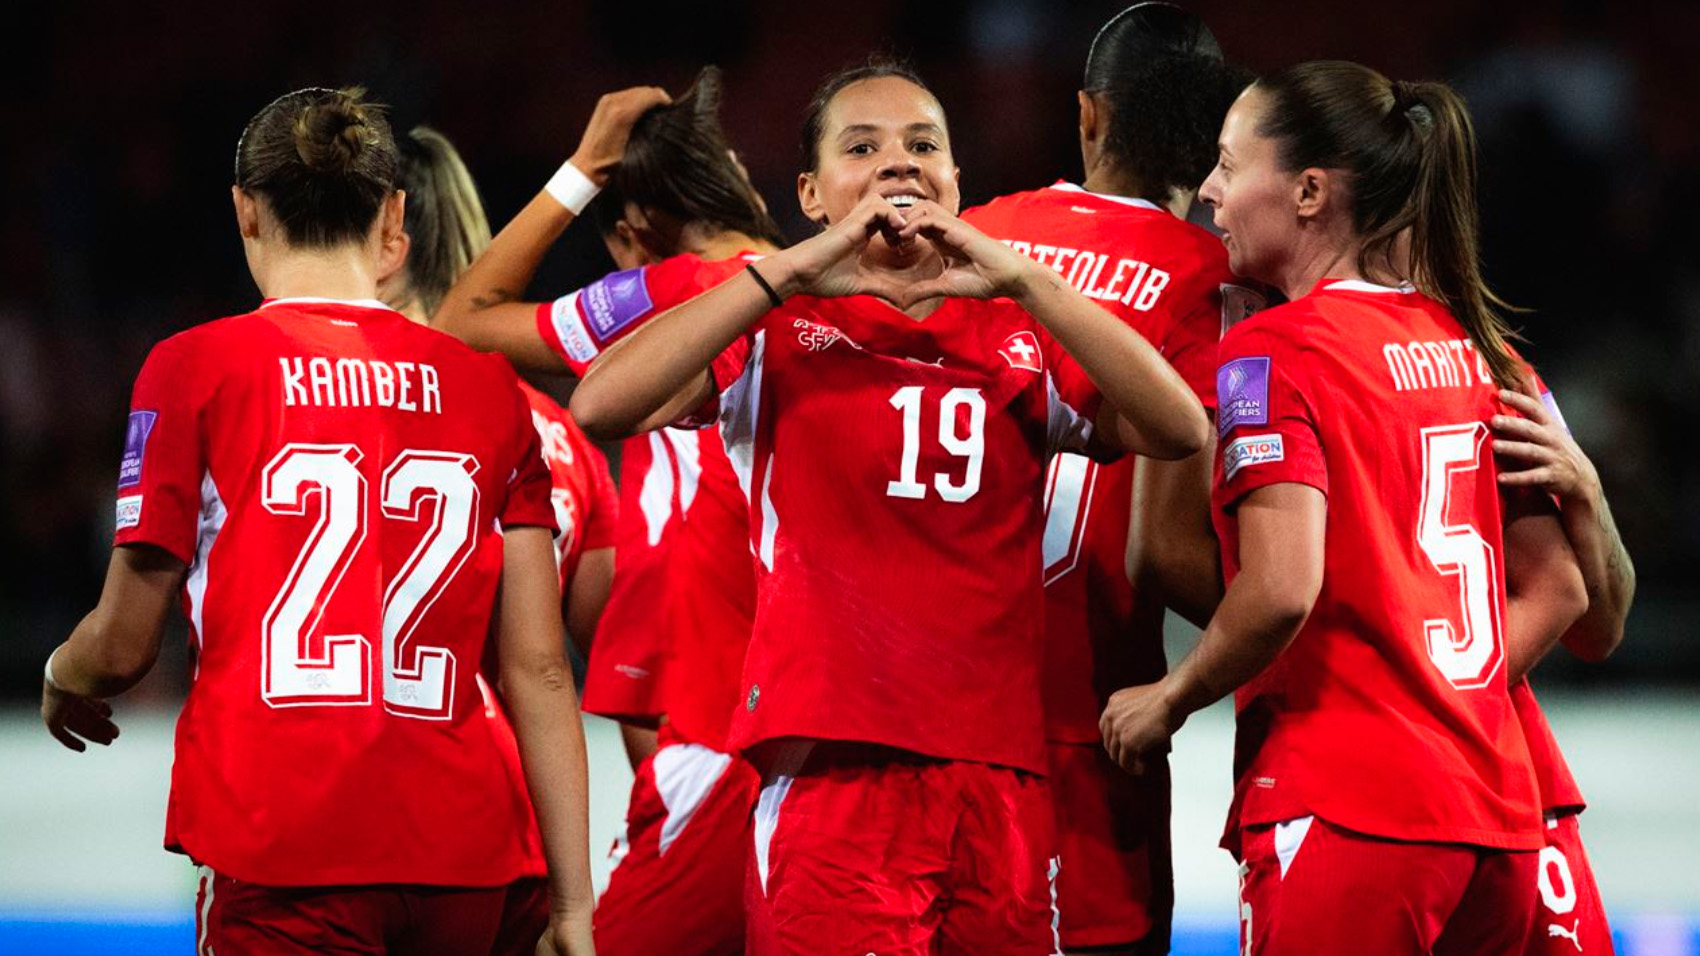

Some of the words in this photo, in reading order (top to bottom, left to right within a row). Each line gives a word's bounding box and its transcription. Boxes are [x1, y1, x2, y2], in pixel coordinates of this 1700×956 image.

[1000, 240, 1171, 312] TENLEIB
[280, 356, 442, 414] KAMBER
[1383, 338, 1493, 391] MARITZ
[886, 386, 987, 503] 19
[260, 442, 482, 721] 22
[1417, 420, 1505, 691] 5
